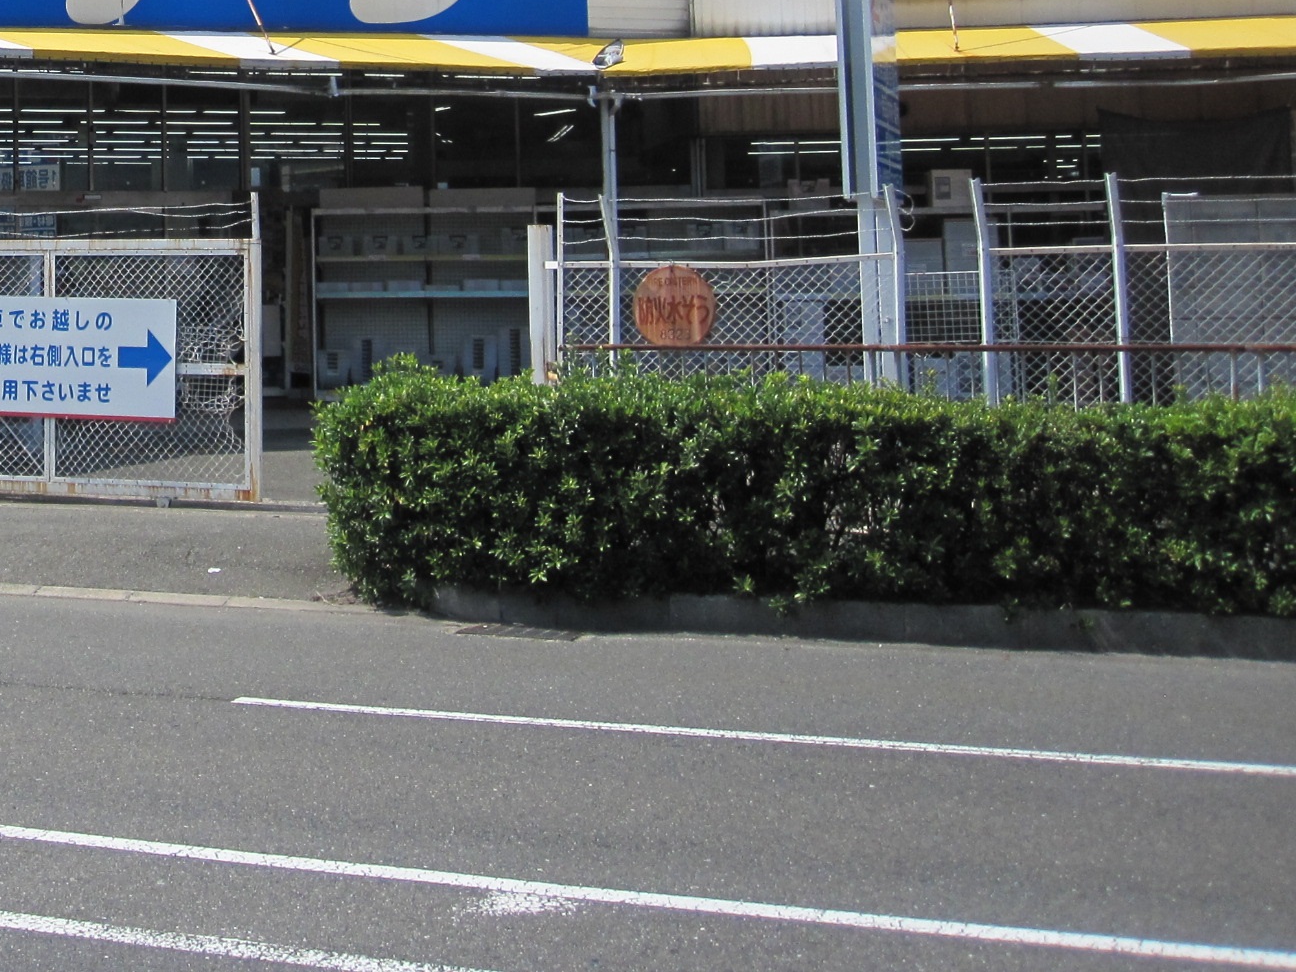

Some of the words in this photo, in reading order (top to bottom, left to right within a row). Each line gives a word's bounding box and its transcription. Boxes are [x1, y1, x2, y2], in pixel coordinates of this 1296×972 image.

[638, 295, 710, 325] 防火水そう
